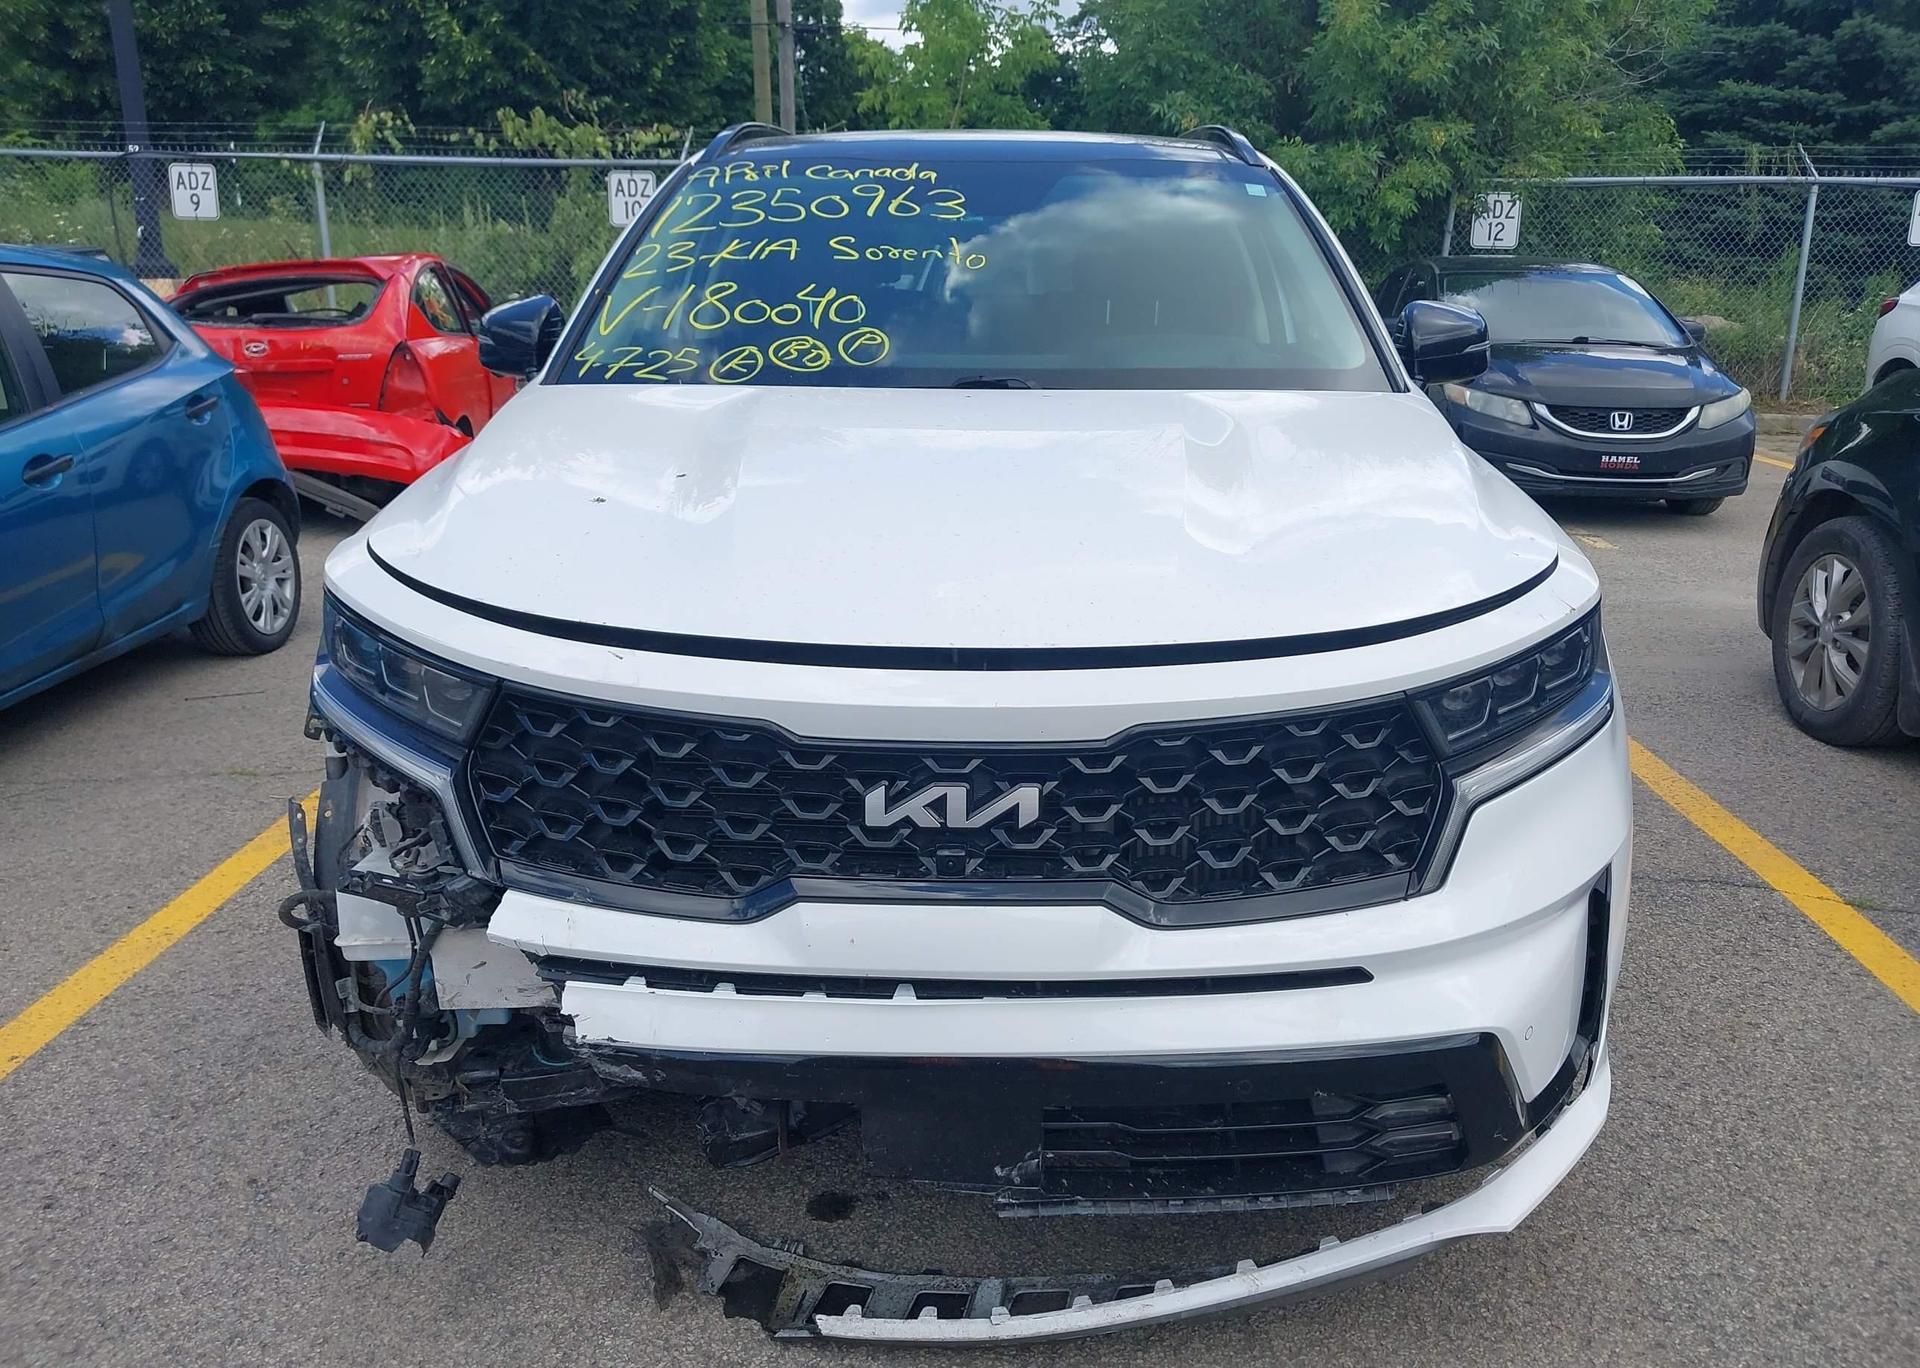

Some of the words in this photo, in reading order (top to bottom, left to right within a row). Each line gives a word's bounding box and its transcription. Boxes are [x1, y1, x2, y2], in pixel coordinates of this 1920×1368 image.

[176, 171, 212, 191] ADZ
[805, 162, 938, 184] Canada
[615, 178, 651, 198] ADZ
[190, 193, 201, 212] 9
[650, 184, 967, 239] 12350963
[1487, 221, 1505, 241] 12
[828, 236, 986, 270] Sorento
[600, 281, 867, 336] V-180040
[574, 342, 700, 381] 4725
[1600, 462, 1639, 470] HONDA
[1601, 455, 1641, 463] HAMEL
